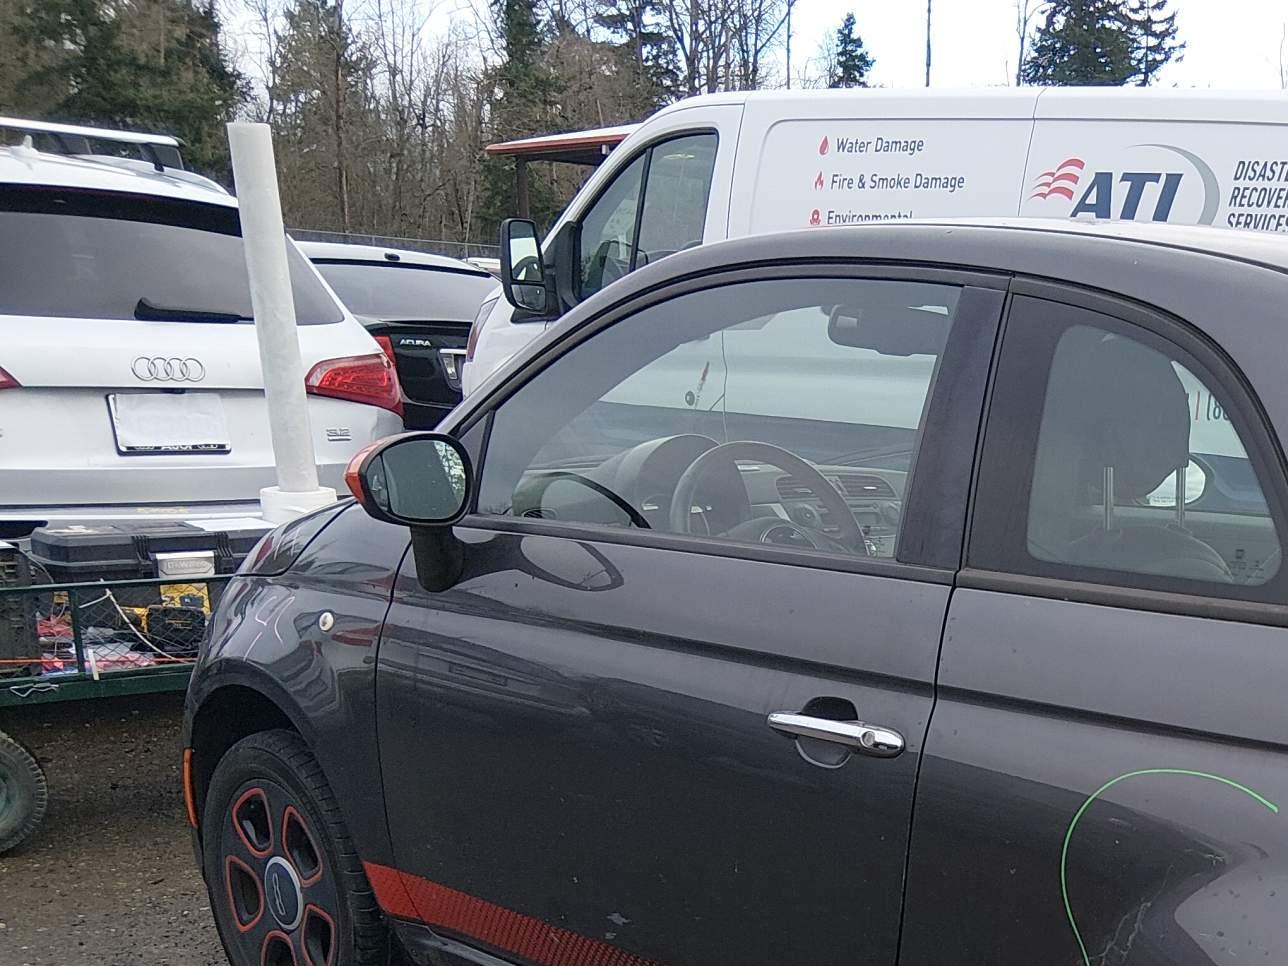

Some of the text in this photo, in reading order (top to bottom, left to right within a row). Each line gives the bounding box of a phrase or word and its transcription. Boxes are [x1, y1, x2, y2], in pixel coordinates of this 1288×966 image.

[836, 137, 925, 155] Water Damage
[830, 173, 965, 193] Fire & Smoke Damage
[1069, 171, 1184, 223] ATI
[400, 339, 431, 347] ACURA
